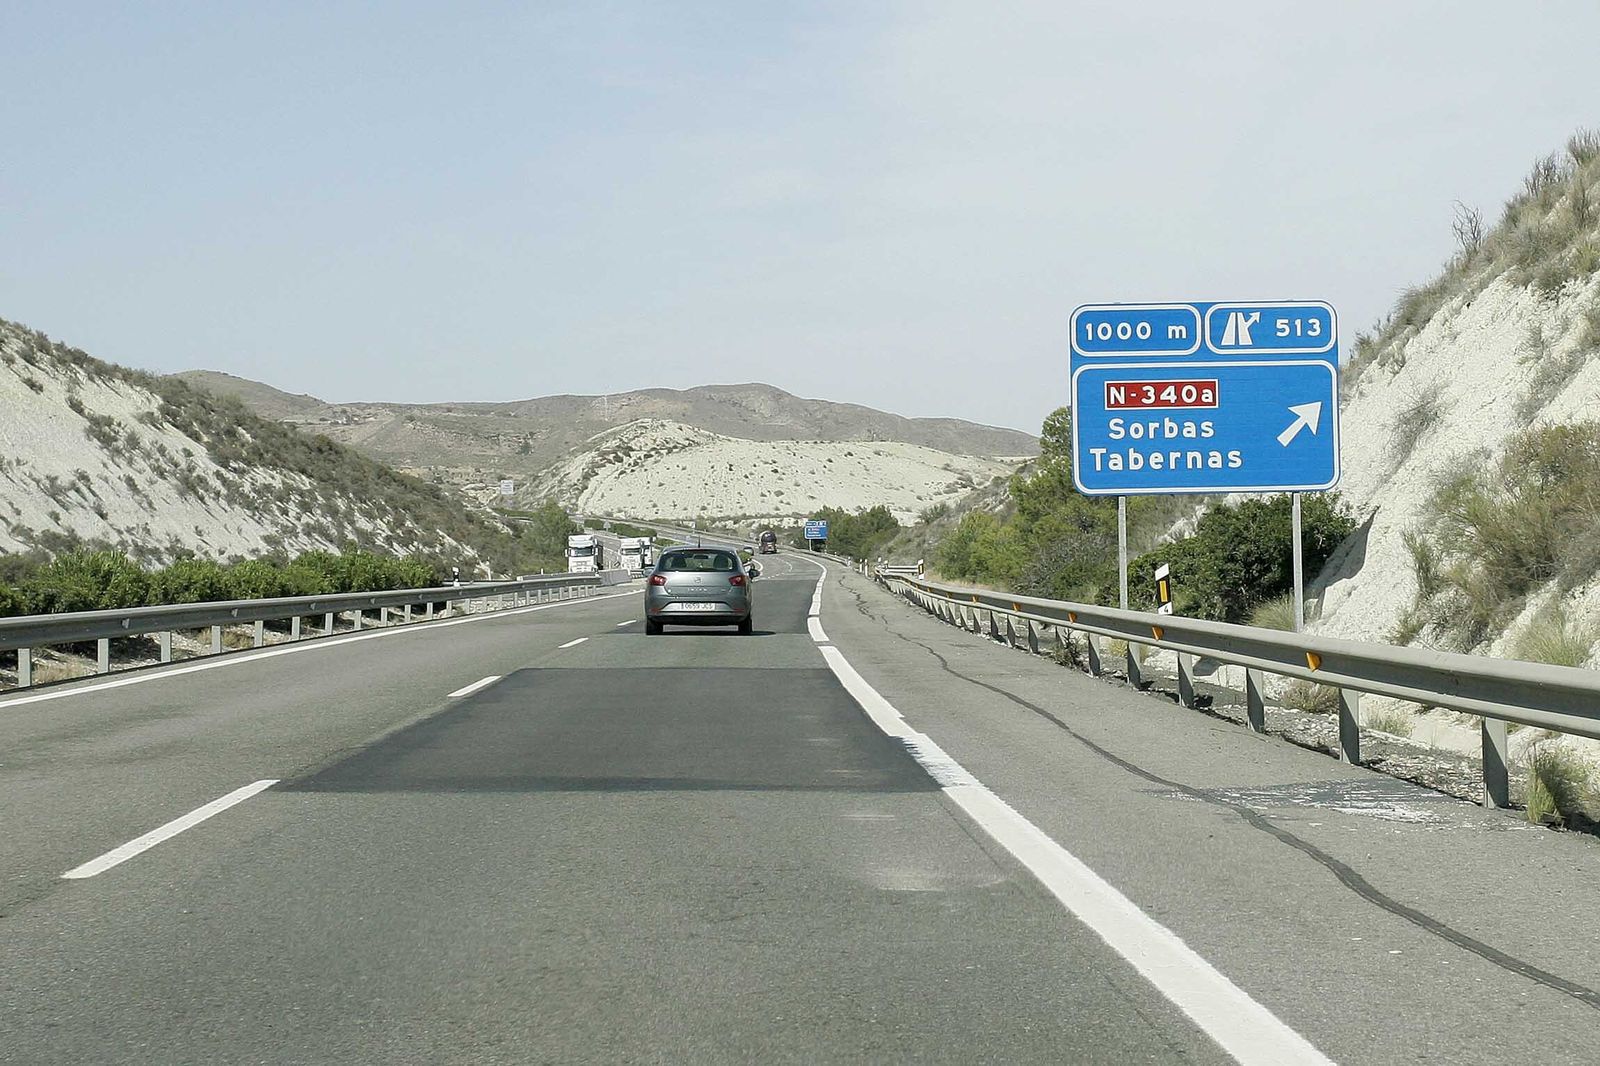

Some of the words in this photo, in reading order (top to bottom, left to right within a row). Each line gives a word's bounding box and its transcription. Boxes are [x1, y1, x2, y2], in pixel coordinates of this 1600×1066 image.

[1085, 321, 1152, 341] 1000
[1167, 325, 1187, 340] m
[1276, 318, 1321, 338] 513
[1109, 384, 1214, 405] N-340a
[1108, 417, 1215, 440] Sorbas
[1090, 447, 1243, 472] Tabernas
